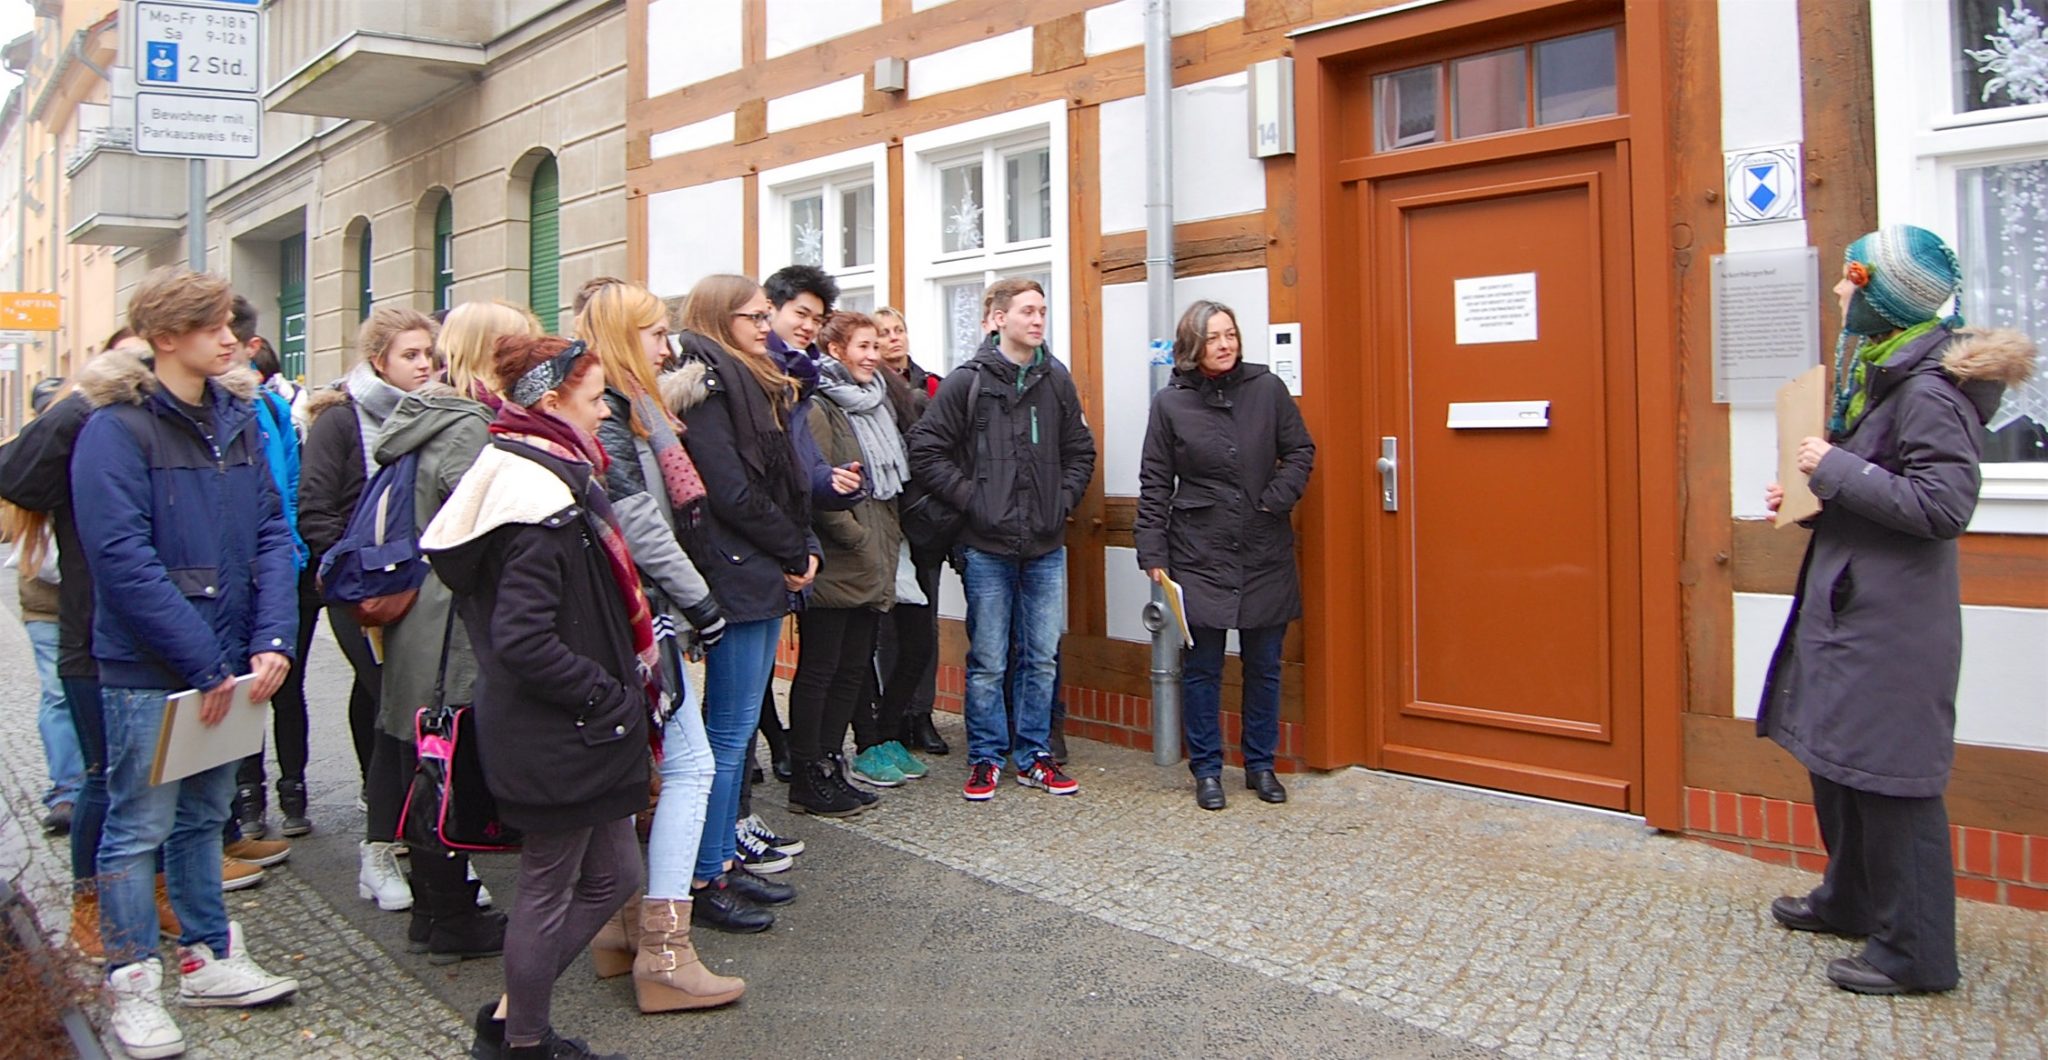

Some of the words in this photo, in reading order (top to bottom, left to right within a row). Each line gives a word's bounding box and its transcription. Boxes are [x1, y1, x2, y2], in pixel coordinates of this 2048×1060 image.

[150, 10, 196, 25] Mo-Fr
[206, 14, 236, 28] 9-18
[165, 27, 183, 40] Sa
[206, 31, 236, 45] 9-12
[188, 55, 200, 73] 2
[207, 57, 248, 77] Std.
[151, 108, 218, 123] Bewohner
[223, 113, 244, 125] mit
[143, 126, 226, 142] Parkausweis
[231, 132, 253, 143] frei
[1258, 122, 1277, 146] 14
